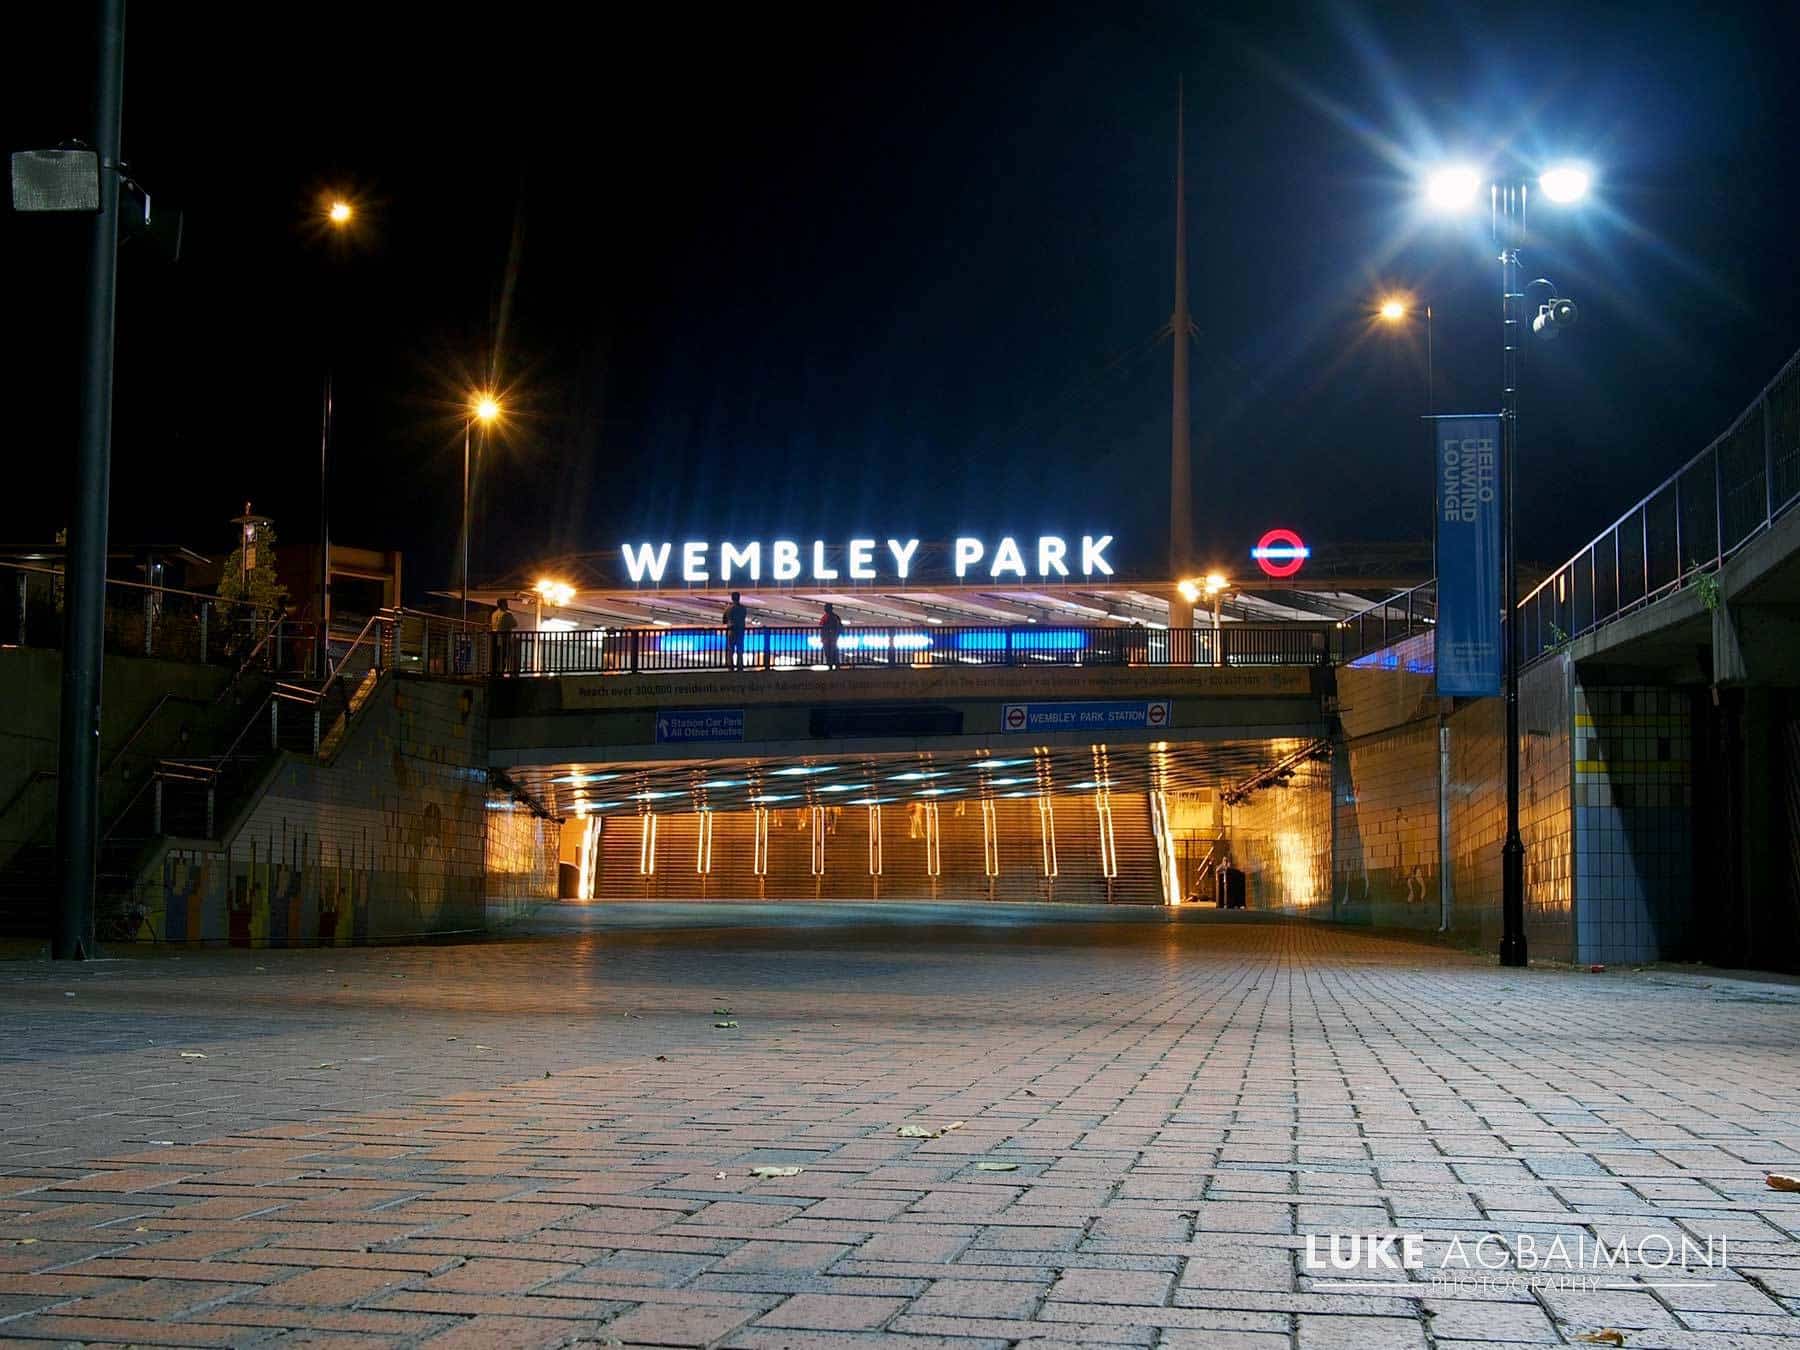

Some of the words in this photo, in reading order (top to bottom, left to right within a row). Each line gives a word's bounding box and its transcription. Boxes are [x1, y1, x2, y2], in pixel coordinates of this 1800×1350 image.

[1444, 439, 1460, 522] LOUNGE
[1461, 438, 1477, 523] UNWIND
[1478, 438, 1494, 503] HELLO
[621, 539, 920, 582] WEMBLEY
[955, 535, 1114, 578] PARK
[670, 728, 682, 737] All
[684, 727, 709, 737] Other
[711, 727, 743, 736] Routes
[671, 718, 704, 728] Station
[706, 717, 721, 727] Car
[723, 717, 742, 727] Park
[1029, 711, 1076, 723] WEMBLEY
[1080, 711, 1104, 721] PARK
[1108, 711, 1145, 721] STATION
